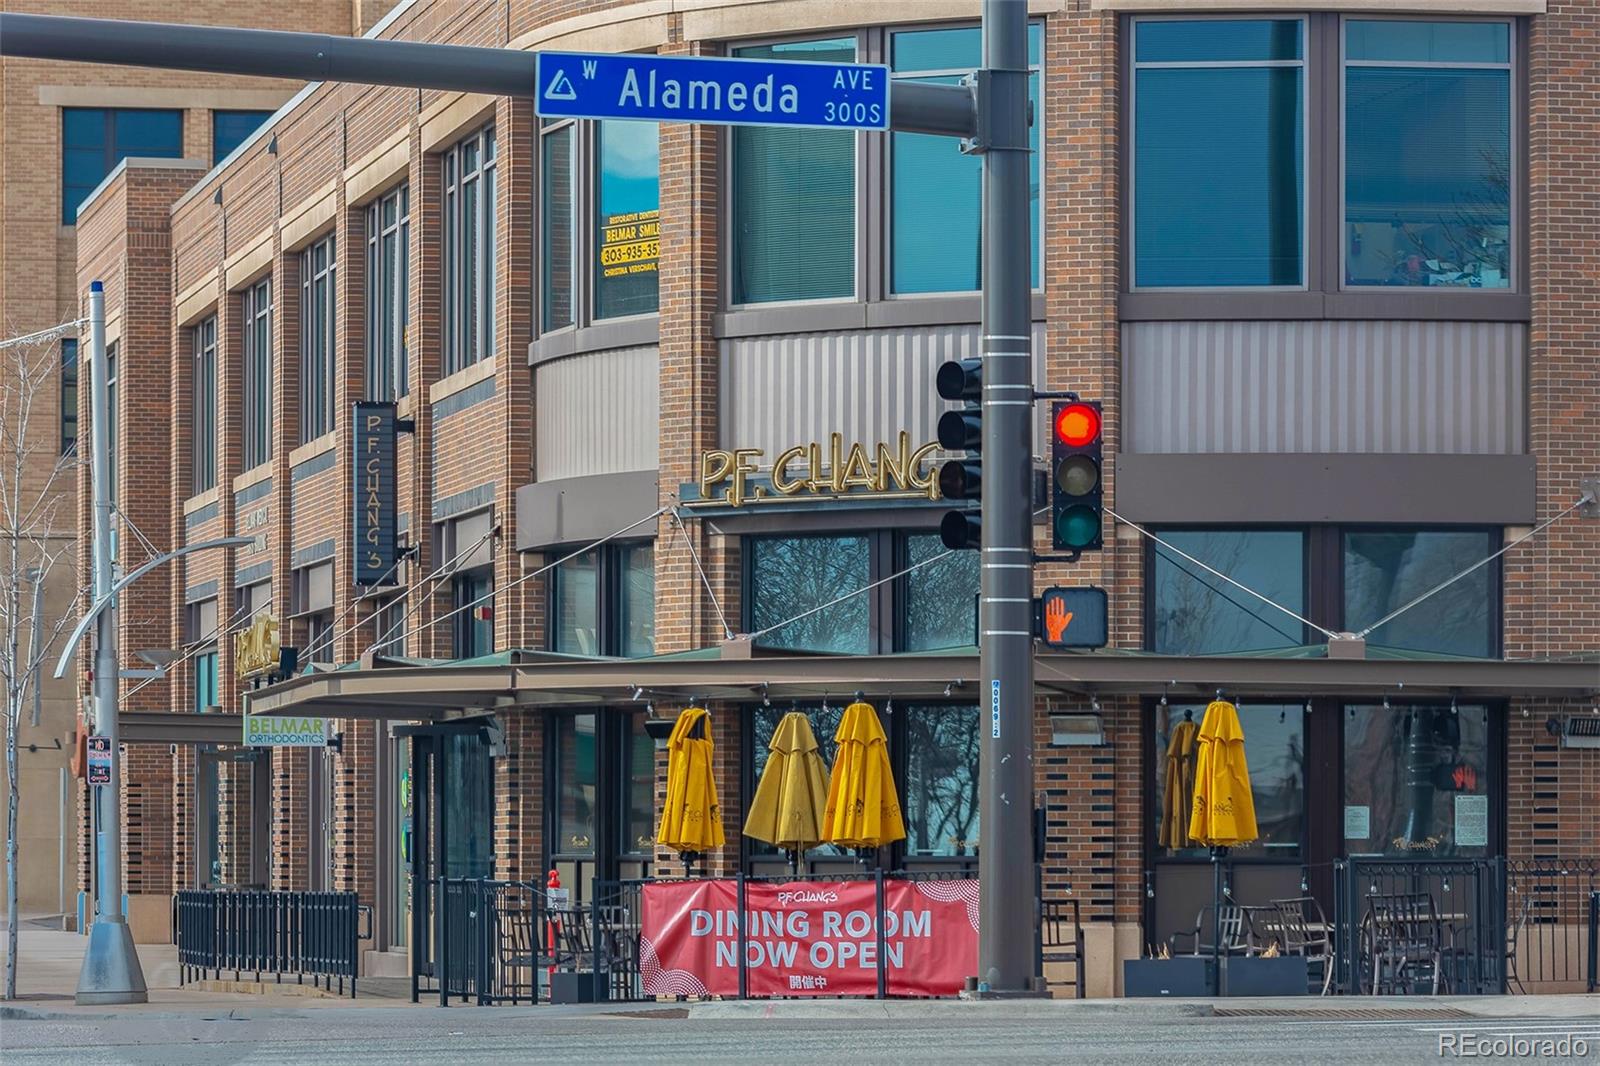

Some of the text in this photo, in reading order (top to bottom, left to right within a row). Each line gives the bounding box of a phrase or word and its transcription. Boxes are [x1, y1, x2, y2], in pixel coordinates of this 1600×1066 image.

[582, 60, 873, 114] W Alameda AVE
[824, 102, 881, 124] 300S
[606, 226, 637, 243] BELMAR
[604, 242, 659, 264] 303-935-35
[249, 718, 323, 734] BELMAR
[95, 740, 104, 751] NO
[249, 734, 324, 744] ORTHODONTICS
[690, 909, 932, 938] DINING ROOM
[715, 940, 904, 969] NOW OPEN
[789, 975, 827, 989] 開催中
